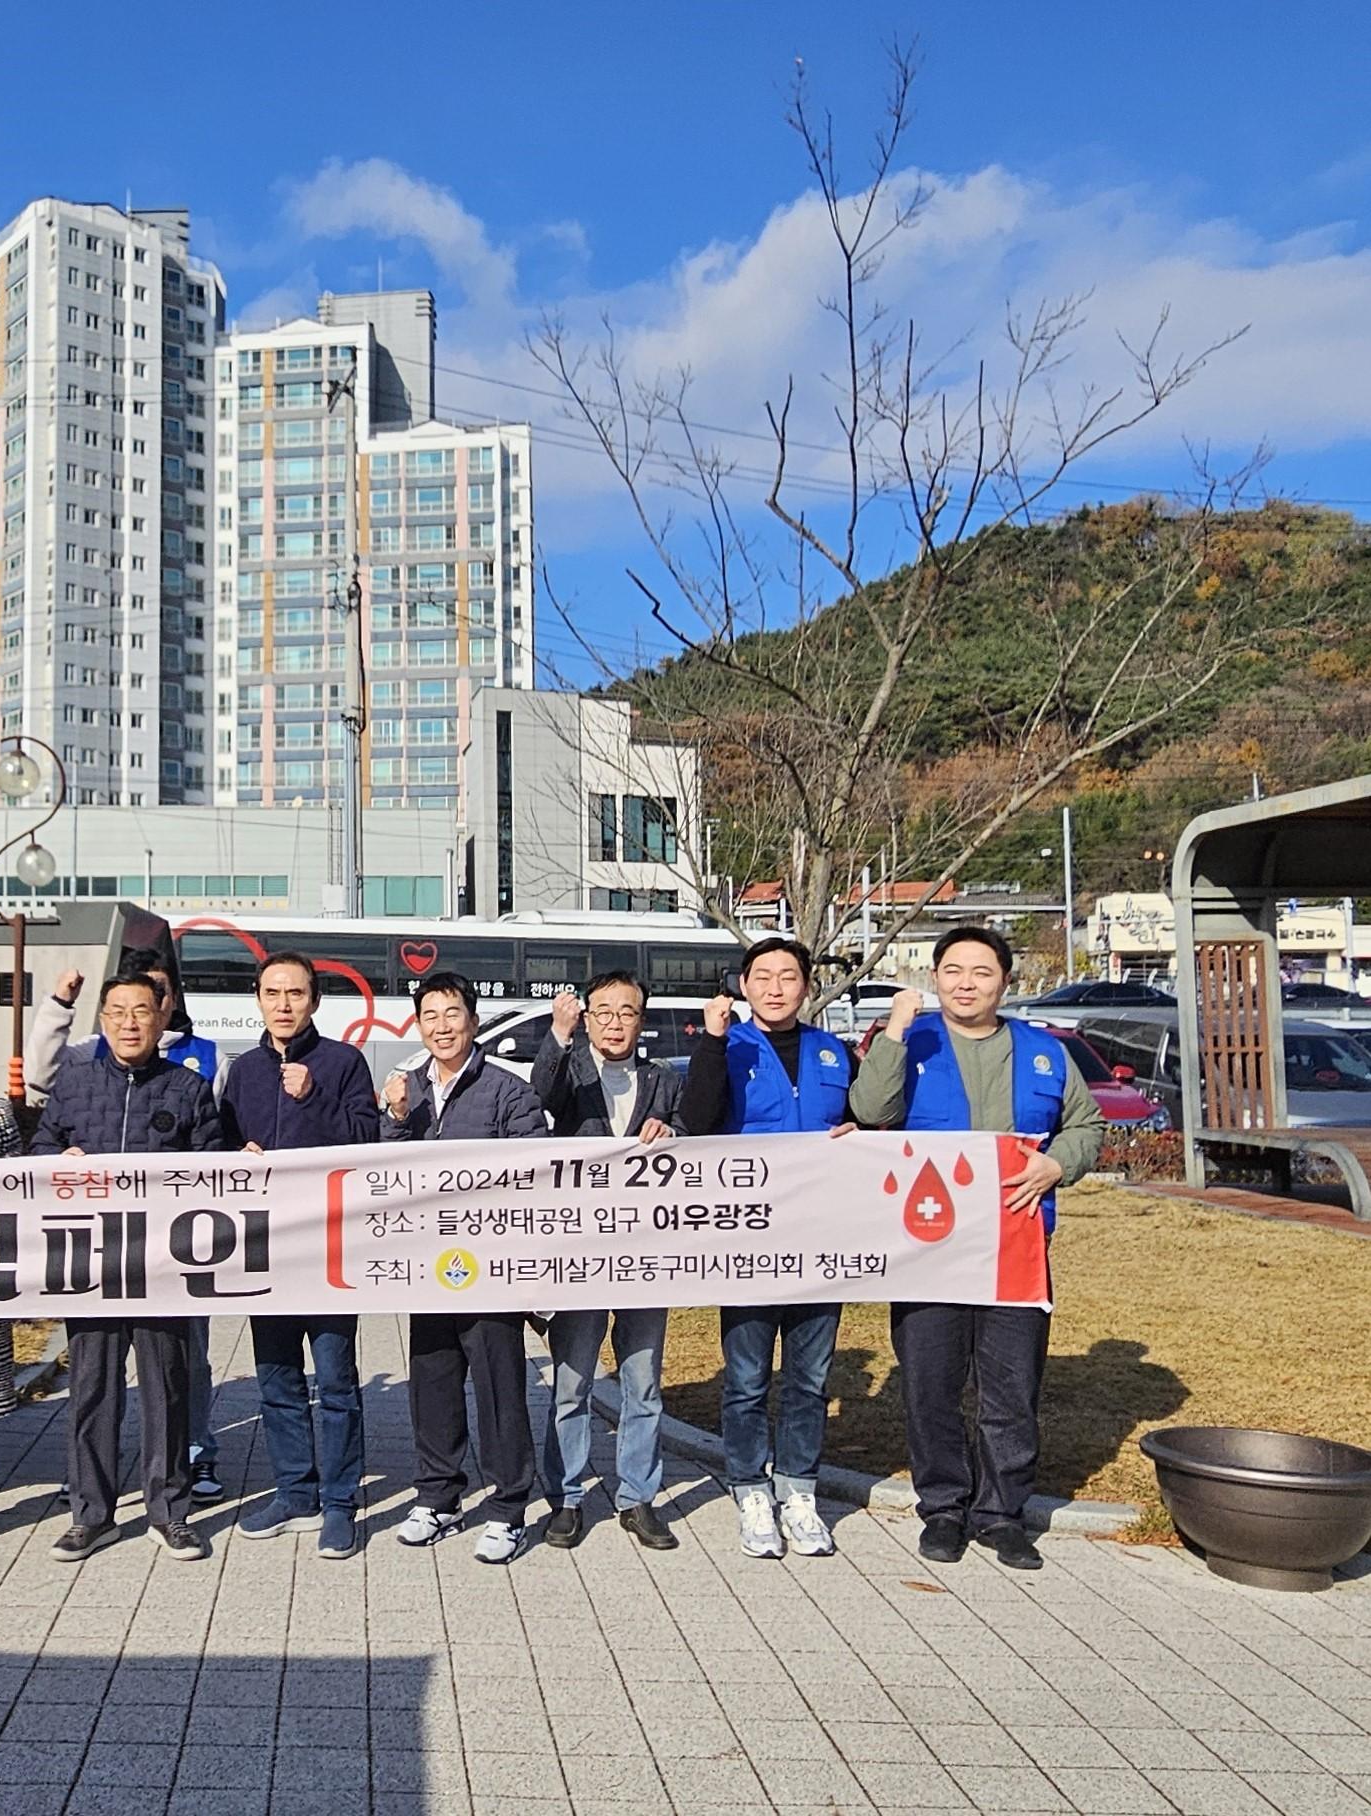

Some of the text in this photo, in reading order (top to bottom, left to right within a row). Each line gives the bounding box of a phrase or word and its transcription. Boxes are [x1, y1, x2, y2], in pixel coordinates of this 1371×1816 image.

[473, 981, 505, 997] 망을
[221, 1017, 243, 1028] Red
[245, 1017, 267, 1028] Cro
[50, 1168, 147, 1200] 동참해
[162, 1166, 271, 1199] 주세요!
[438, 1167, 535, 1193] 2024년
[549, 1159, 611, 1189] 11월
[624, 1153, 703, 1188] 29일
[717, 1157, 769, 1188] (금)
[437, 1207, 583, 1236] 들성생태공원
[594, 1206, 641, 1234] 입구
[652, 1203, 772, 1231] 여우광장
[490, 1253, 803, 1285] 바르게살기운동구미시협의회
[815, 1252, 888, 1280] 청년회
